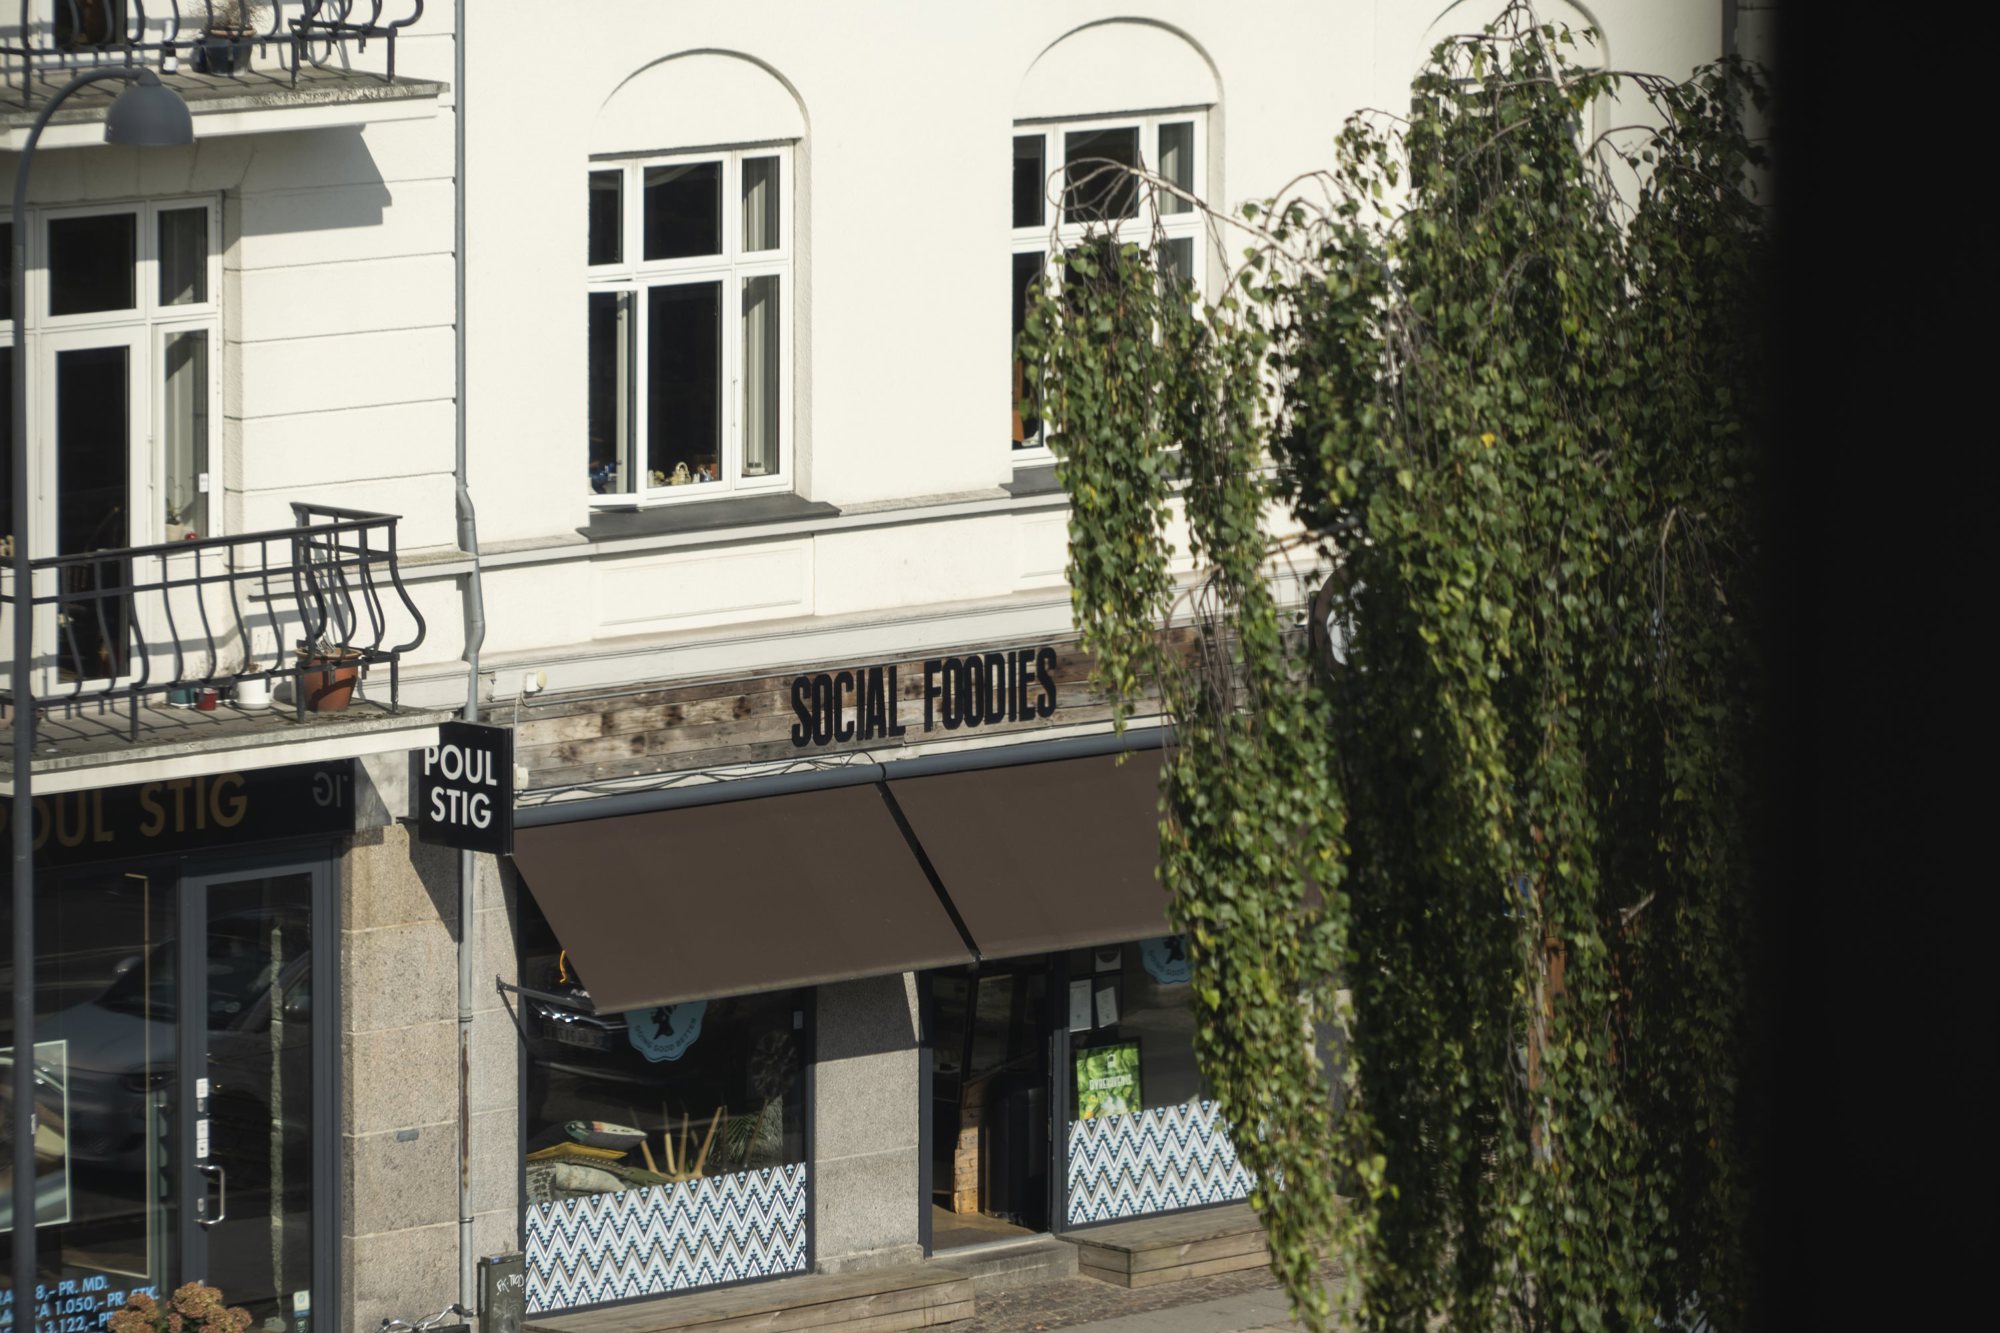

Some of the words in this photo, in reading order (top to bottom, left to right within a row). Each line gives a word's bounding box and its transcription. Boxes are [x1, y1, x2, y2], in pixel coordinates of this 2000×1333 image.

[791, 664, 906, 748] SOCIAL
[923, 646, 1057, 733] FOODIES
[424, 744, 498, 786] POUL
[0, 789, 115, 852] OUL
[138, 771, 248, 838] STIG
[430, 786, 492, 829] STIG
[55, 1296, 104, 1315] 1.050,-
[106, 1291, 127, 1306] PR.
[58, 1280, 79, 1296] PR.
[82, 1275, 109, 1292] MD.
